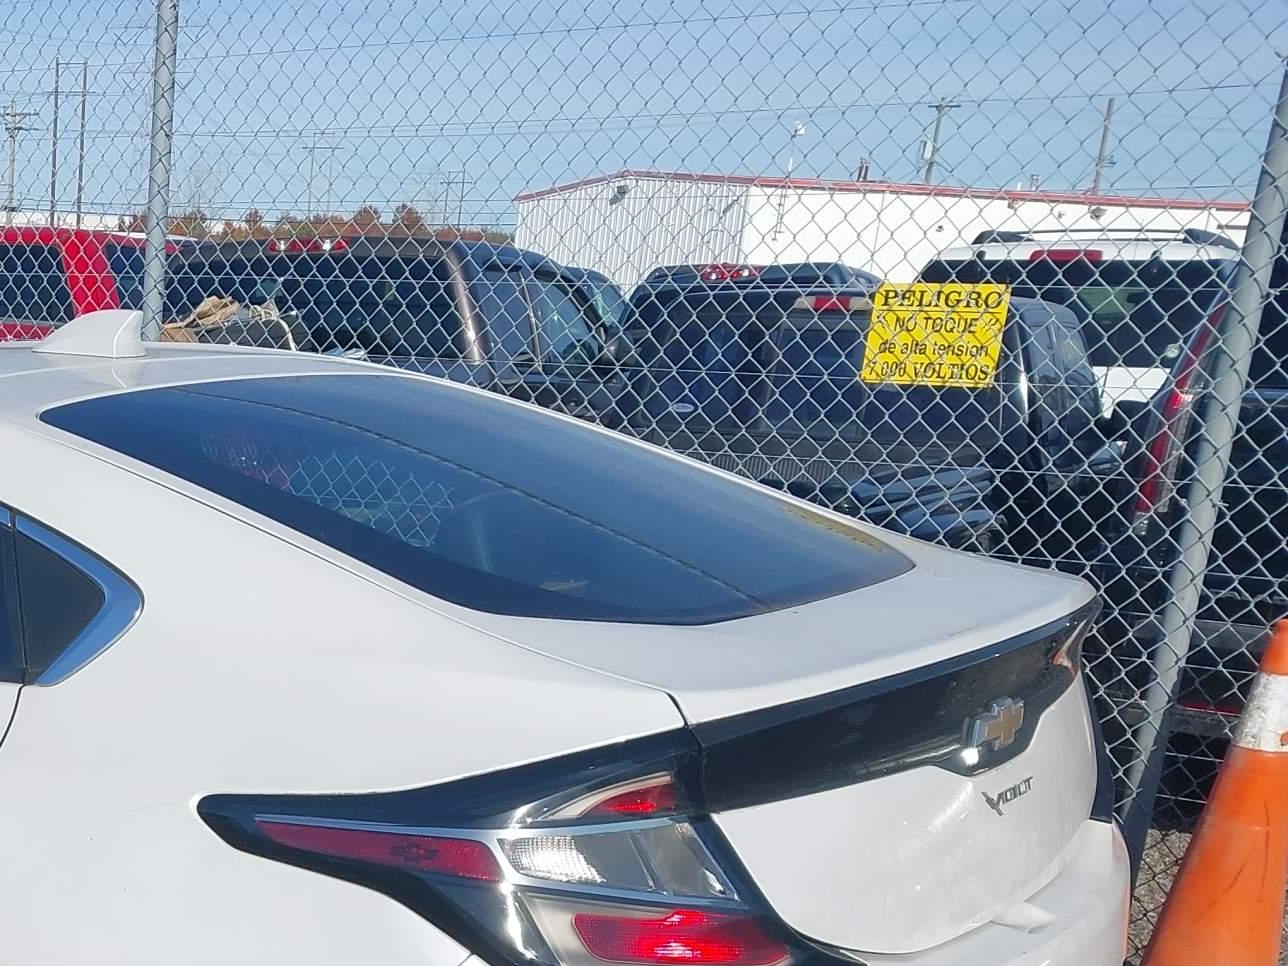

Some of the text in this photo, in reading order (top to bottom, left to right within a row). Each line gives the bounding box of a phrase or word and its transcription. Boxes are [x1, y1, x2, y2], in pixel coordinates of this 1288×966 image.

[881, 288, 1004, 310] PELIGRO
[894, 316, 979, 334] NO TOQUE
[878, 339, 989, 357] de alta tension
[912, 361, 991, 382] VOLTIOS
[981, 775, 1035, 817] VOLT
